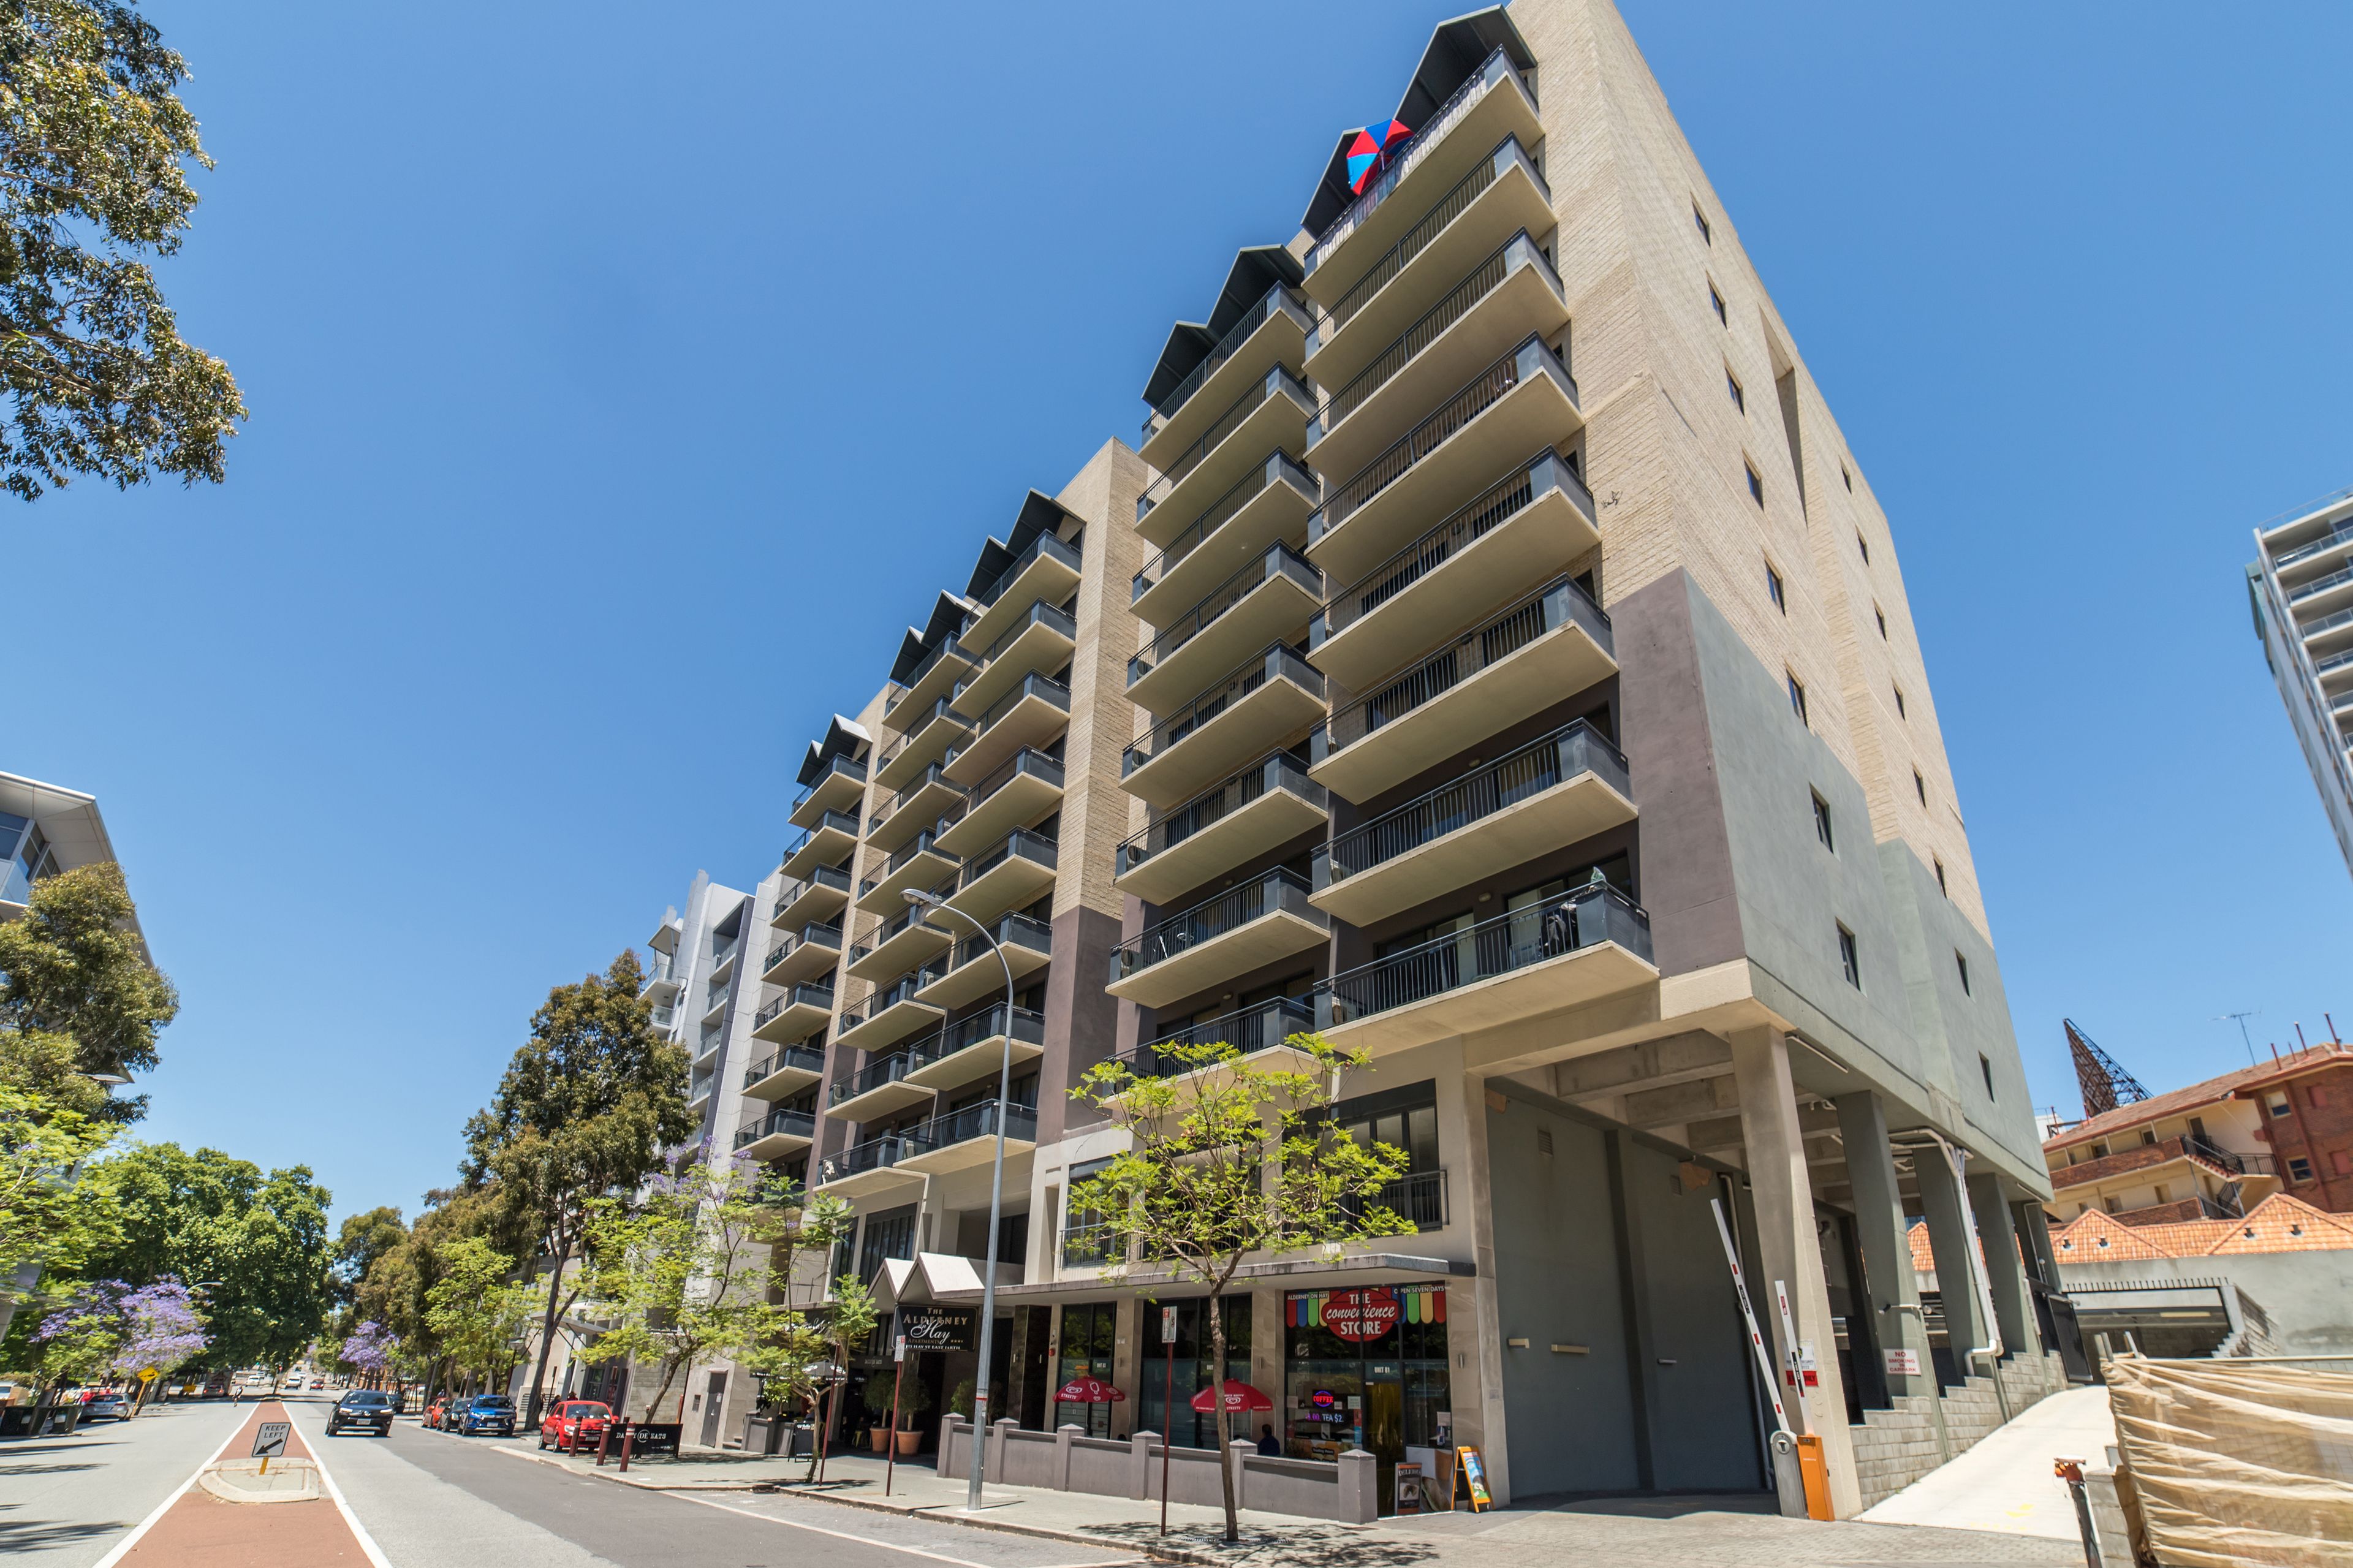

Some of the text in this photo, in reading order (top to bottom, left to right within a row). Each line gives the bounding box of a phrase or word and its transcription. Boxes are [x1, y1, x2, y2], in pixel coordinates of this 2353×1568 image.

[1349, 1293, 1370, 1305] THE
[1327, 1305, 1395, 1320] convenience
[903, 1314, 968, 1325] ALDERNEY
[911, 1319, 950, 1344] Hay
[1341, 1321, 1381, 1335] STORE
[1322, 1414, 1333, 1422] TEA
